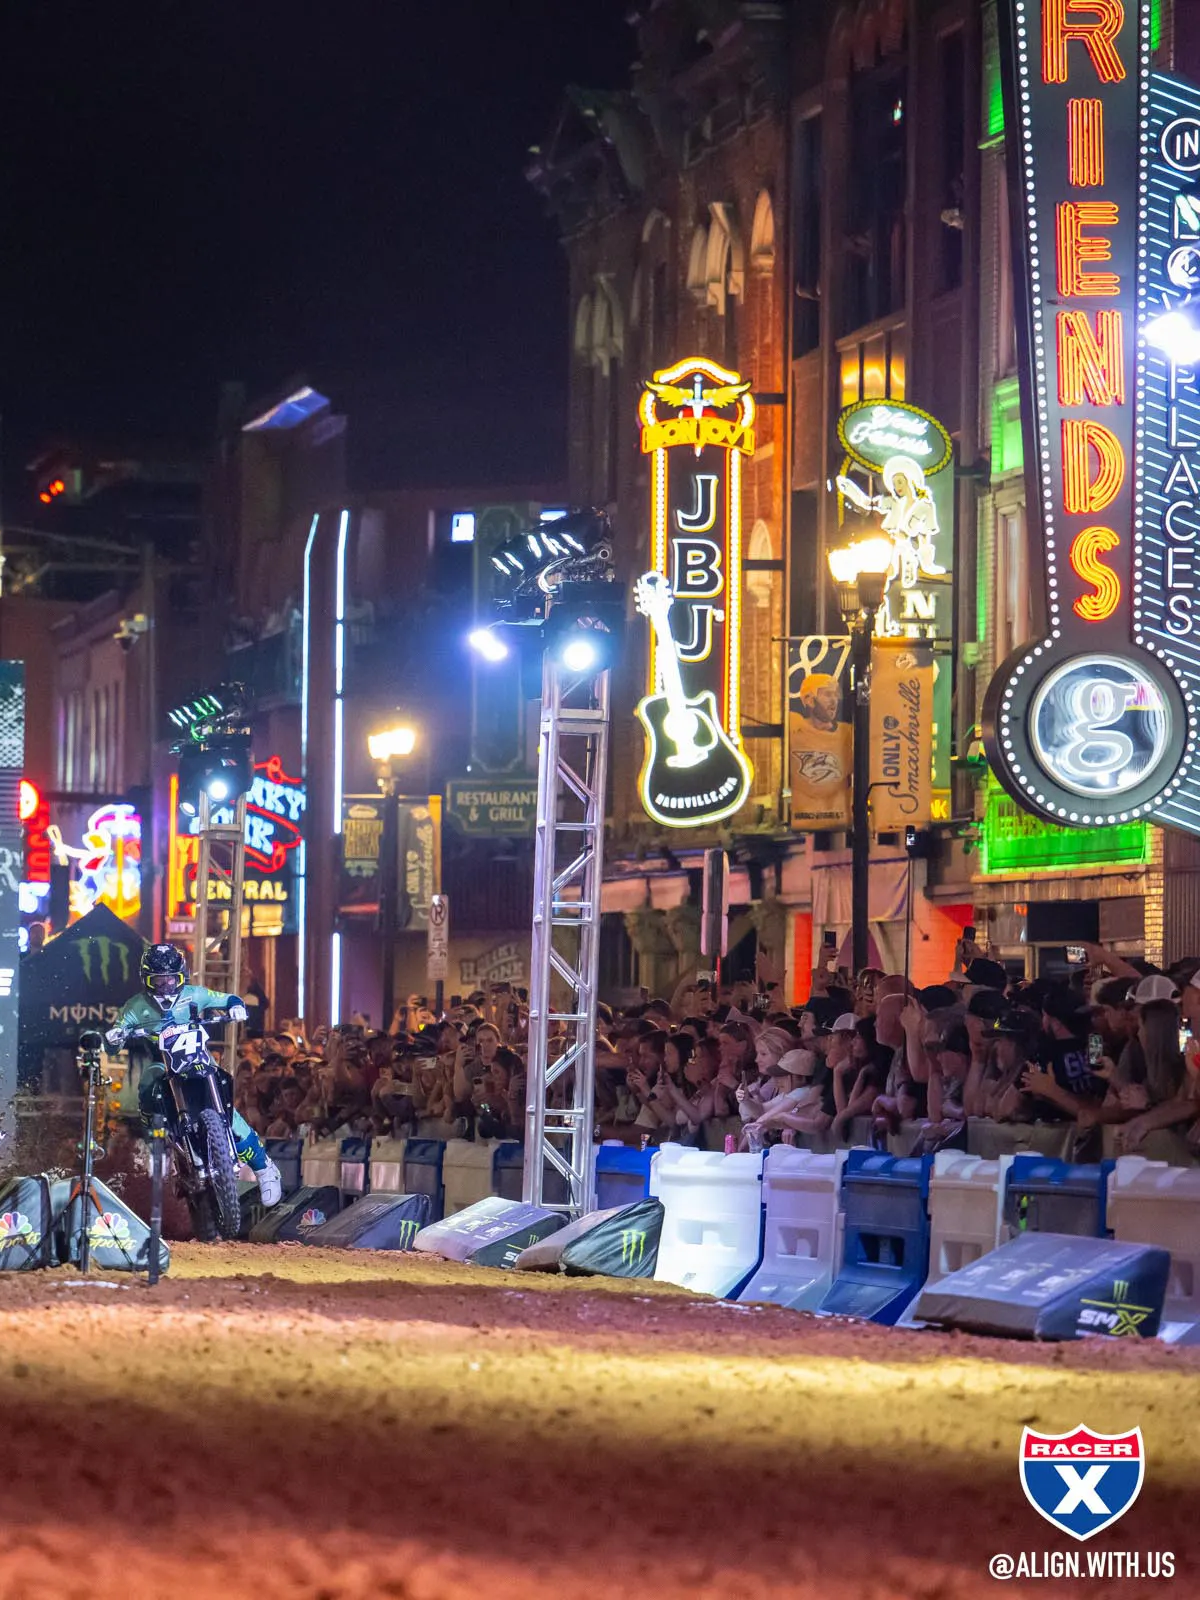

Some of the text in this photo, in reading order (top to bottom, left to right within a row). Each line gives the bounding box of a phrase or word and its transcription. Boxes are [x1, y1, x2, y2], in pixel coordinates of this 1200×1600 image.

[1175, 129, 1199, 161] IN
[1067, 678, 1136, 775] g
[883, 732, 900, 778] ONLY
[888, 677, 921, 814] Smashville
[246, 776, 306, 821] NKY
[457, 791, 538, 806] RESTAURANT
[489, 807, 526, 821] GRILL
[190, 879, 288, 901] CENRAL
[49, 1003, 119, 1025] MONS
[171, 1031, 201, 1055] 4
[1077, 1308, 1148, 1338] SMX
